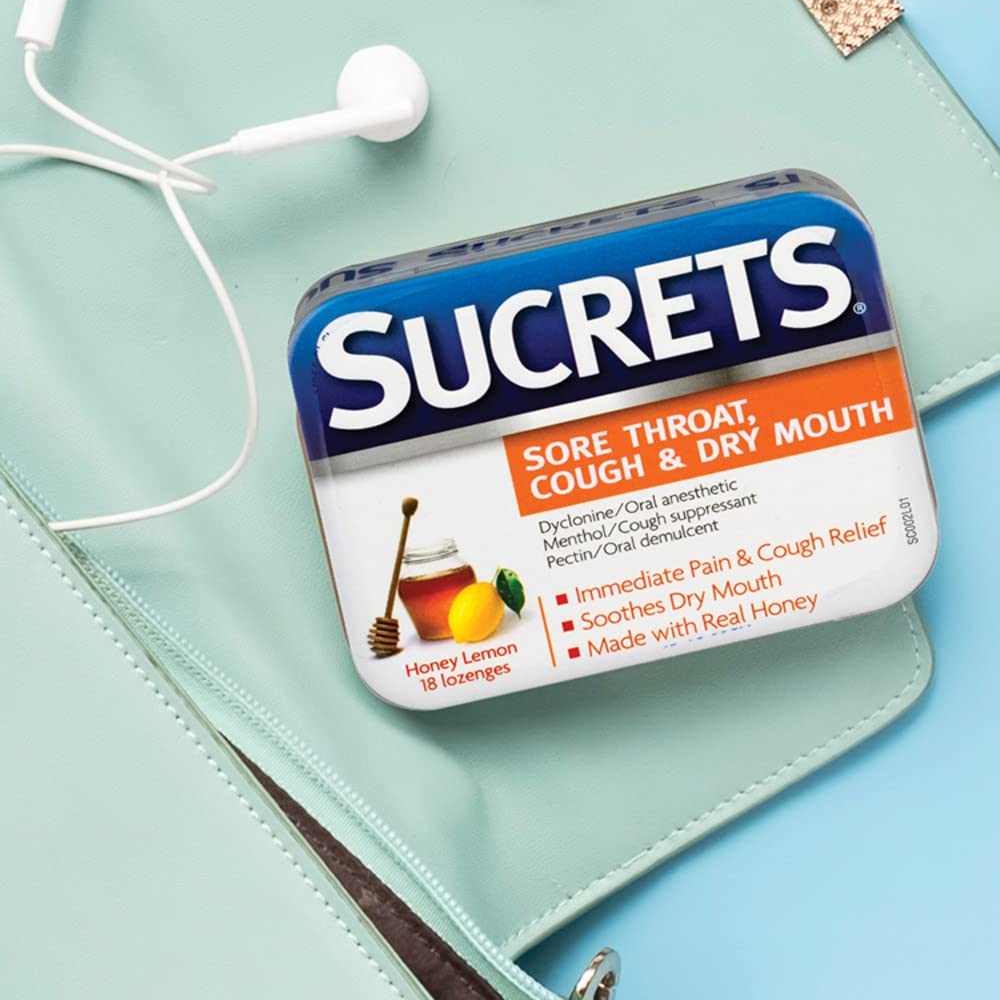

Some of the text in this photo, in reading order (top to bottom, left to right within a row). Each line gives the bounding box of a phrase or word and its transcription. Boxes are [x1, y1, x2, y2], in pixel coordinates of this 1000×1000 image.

[524, 399, 759, 471] SORE THROAT,
[531, 398, 893, 499] COUGH & DRY MOUTH
[538, 480, 738, 536] Dyclonine/Oral anesthetic
[543, 493, 757, 551] Menthol/Cough suppressant
[898, 496, 920, 546] SC002L01
[546, 520, 719, 569] Pectin/Oral demulcent
[574, 514, 887, 604] Immediate Pain & Cough Relief
[579, 569, 783, 632] Soothes Dry Mouth
[586, 592, 819, 658] Made with Real Honey
[404, 642, 519, 678] Honey Lemon
[419, 662, 512, 692] 18 lozenges
